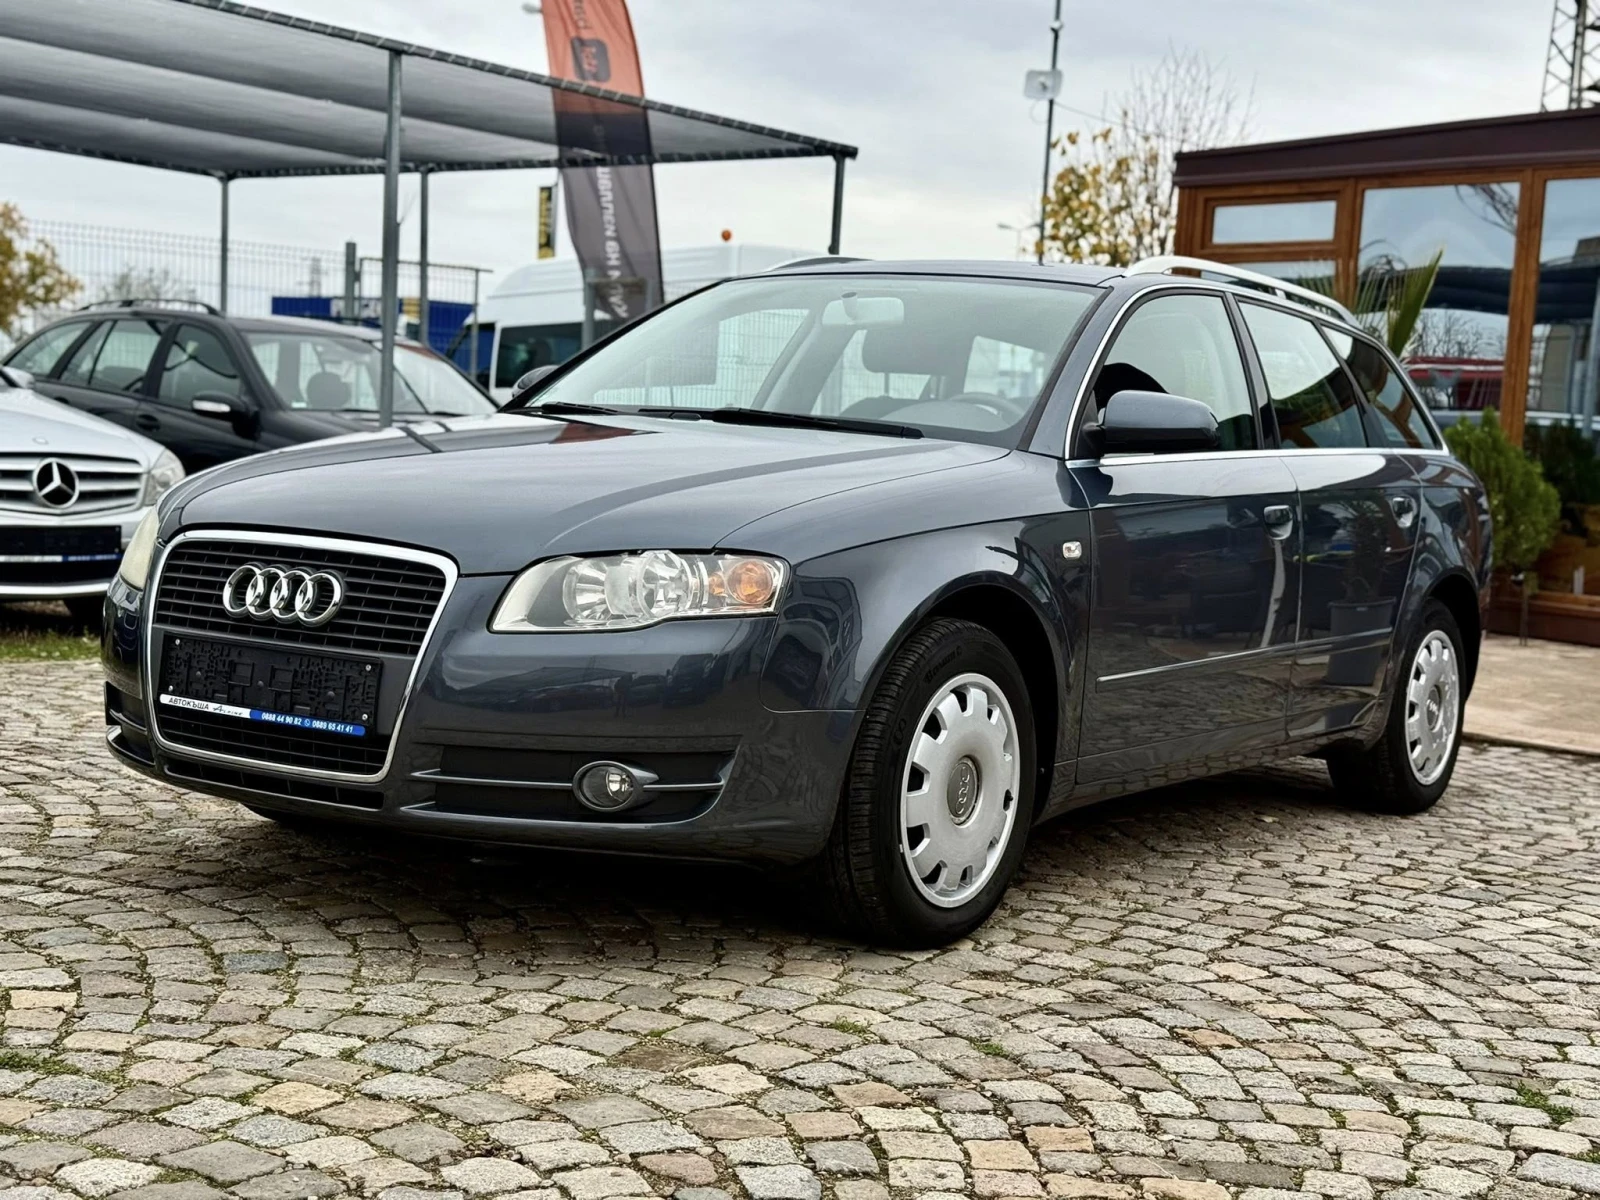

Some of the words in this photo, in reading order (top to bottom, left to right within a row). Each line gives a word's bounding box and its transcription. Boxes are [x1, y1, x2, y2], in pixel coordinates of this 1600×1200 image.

[261, 712, 276, 722] 0888
[276, 714, 284, 722] 44
[285, 716, 293, 724] 90
[294, 717, 302, 725] 82
[312, 720, 327, 729] 0889
[328, 722, 336, 731] 65
[336, 724, 345, 732] 41
[345, 725, 353, 733] 41
